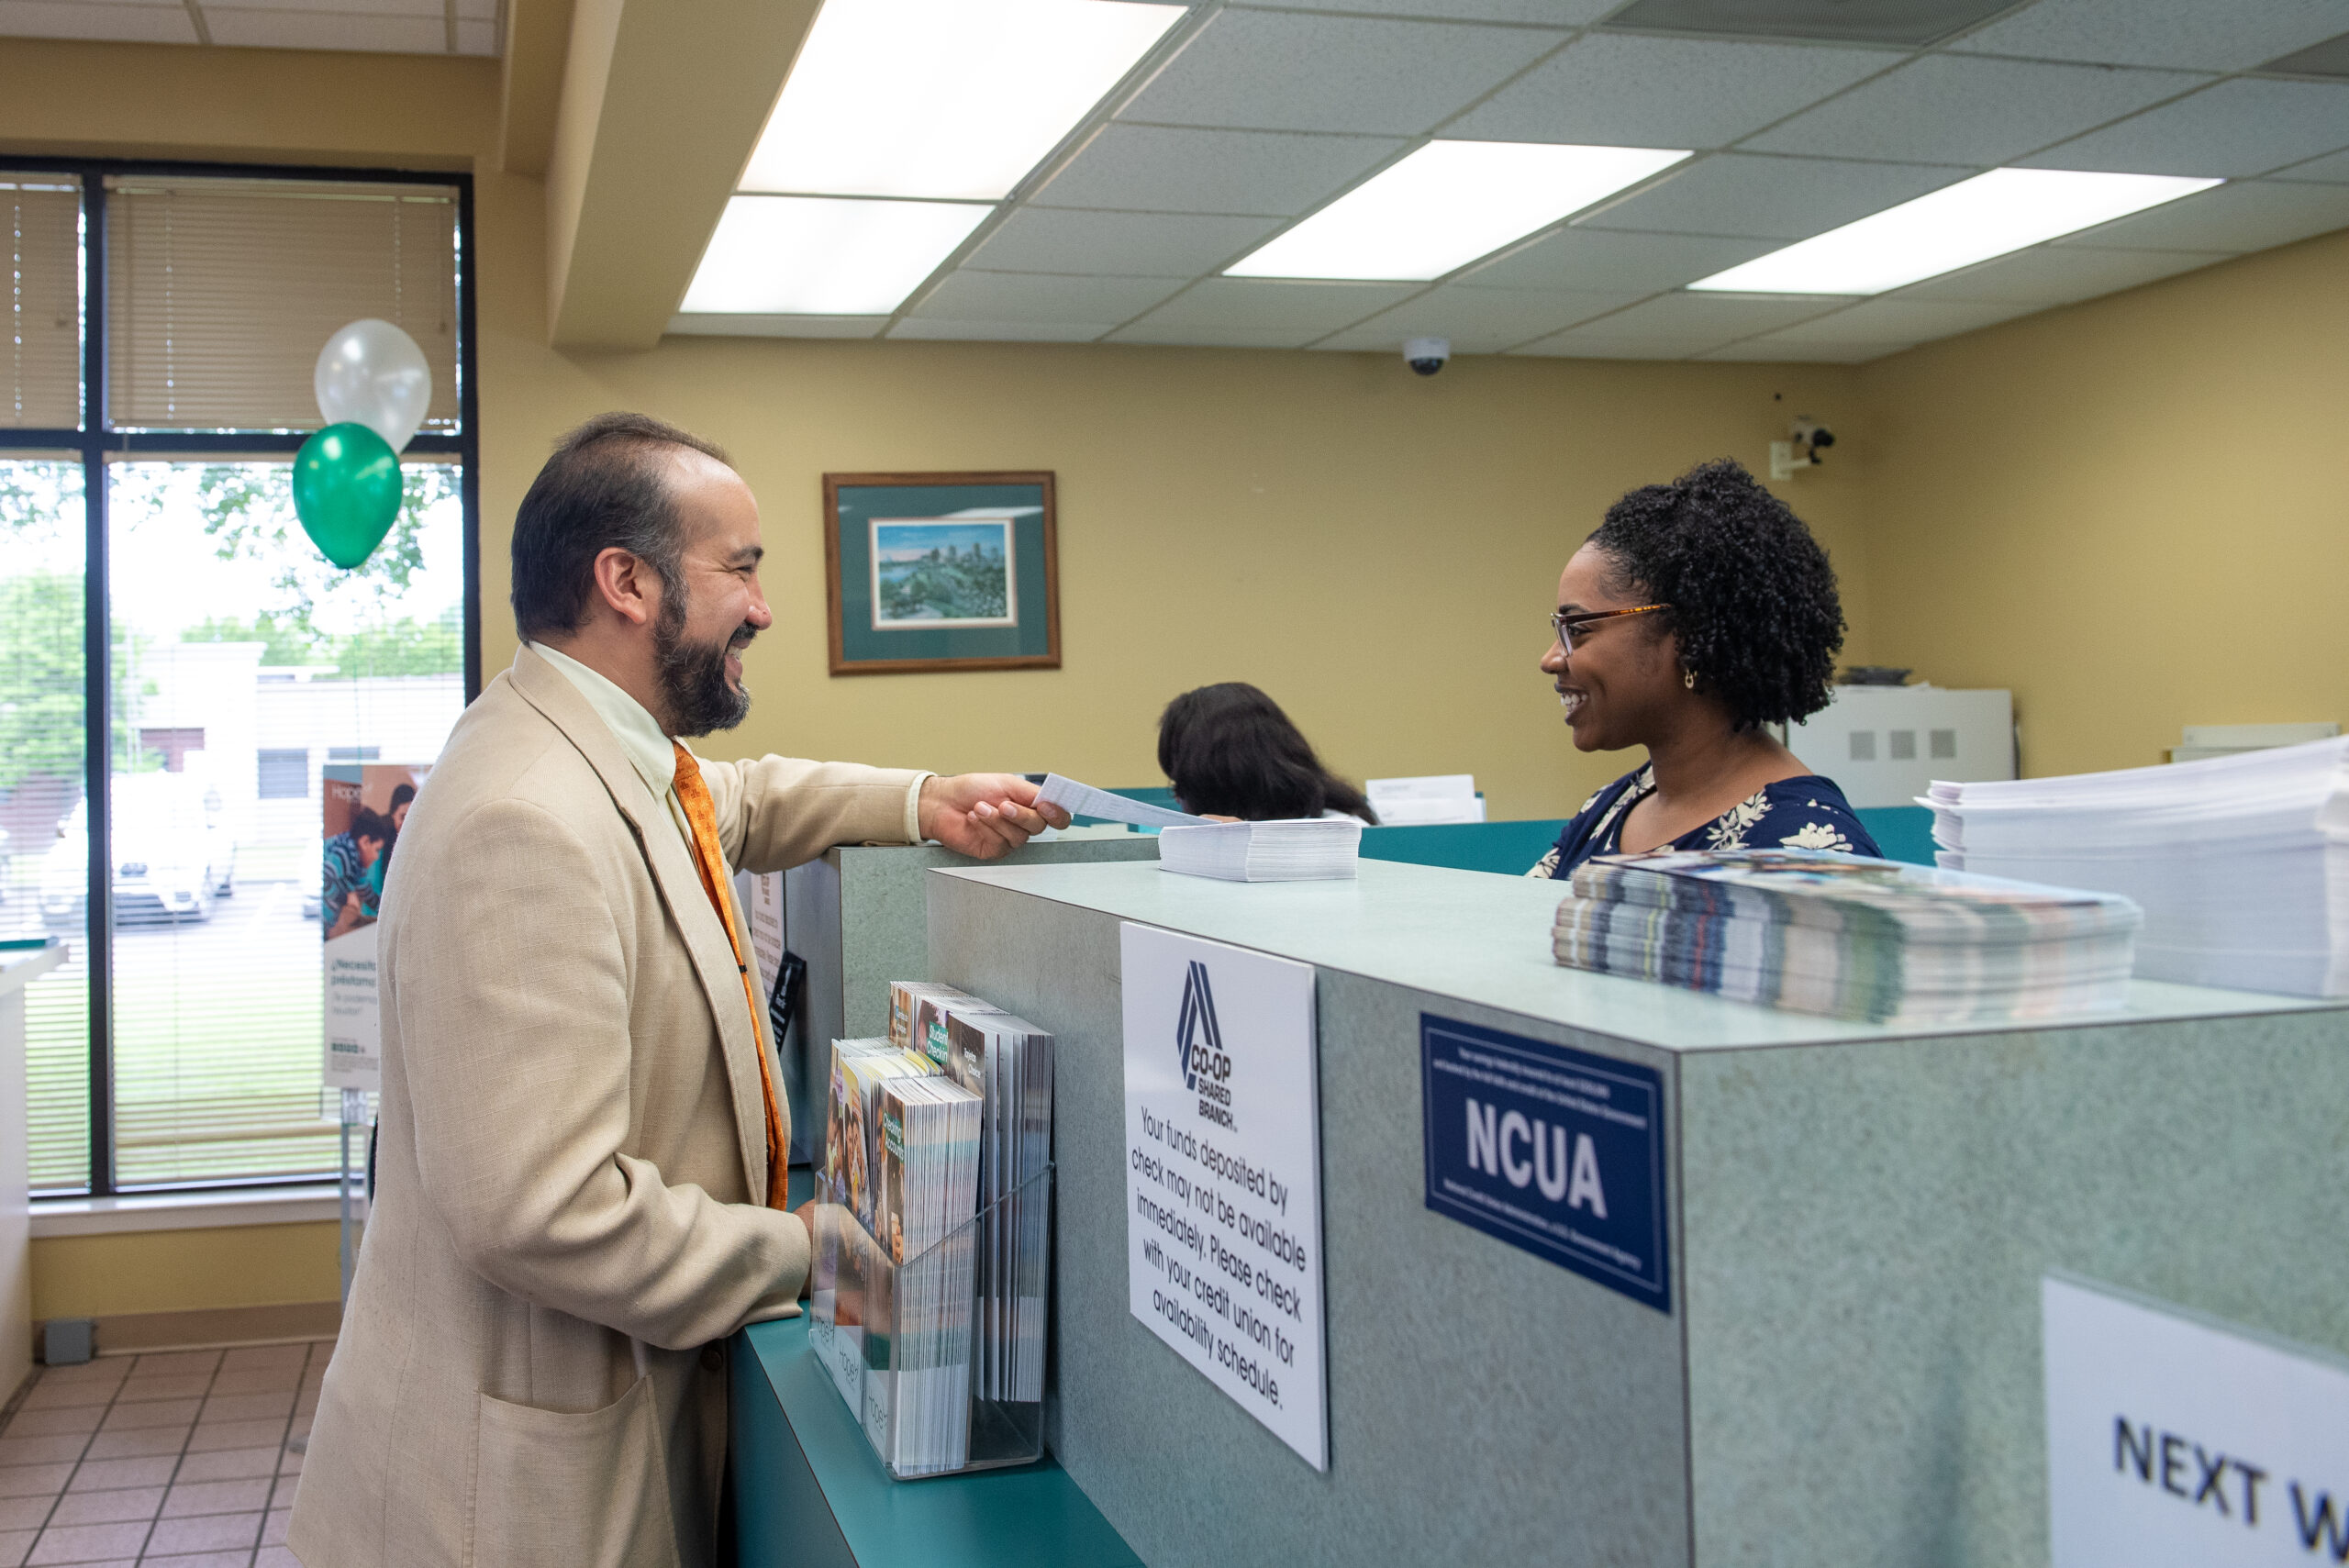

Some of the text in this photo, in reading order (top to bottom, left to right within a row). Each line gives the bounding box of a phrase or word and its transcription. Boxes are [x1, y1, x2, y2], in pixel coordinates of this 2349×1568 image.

[927, 1040, 948, 1063] Checkin
[1192, 1044, 1231, 1083] CO-OP
[1198, 1077, 1231, 1106] SHARED
[884, 1112, 903, 1143] Checking
[1141, 1106, 1288, 1217] Your funds deposited by
[1198, 1099, 1233, 1130] BRANCH
[1465, 1097, 1609, 1220] NCUA
[1132, 1146, 1306, 1273] check may not be available
[1137, 1186, 1302, 1323] immediately. Please check
[1143, 1239, 1295, 1368] with your credit union for
[1153, 1289, 1284, 1411] availability schedule.
[2114, 1415, 2267, 1527] NEXT
